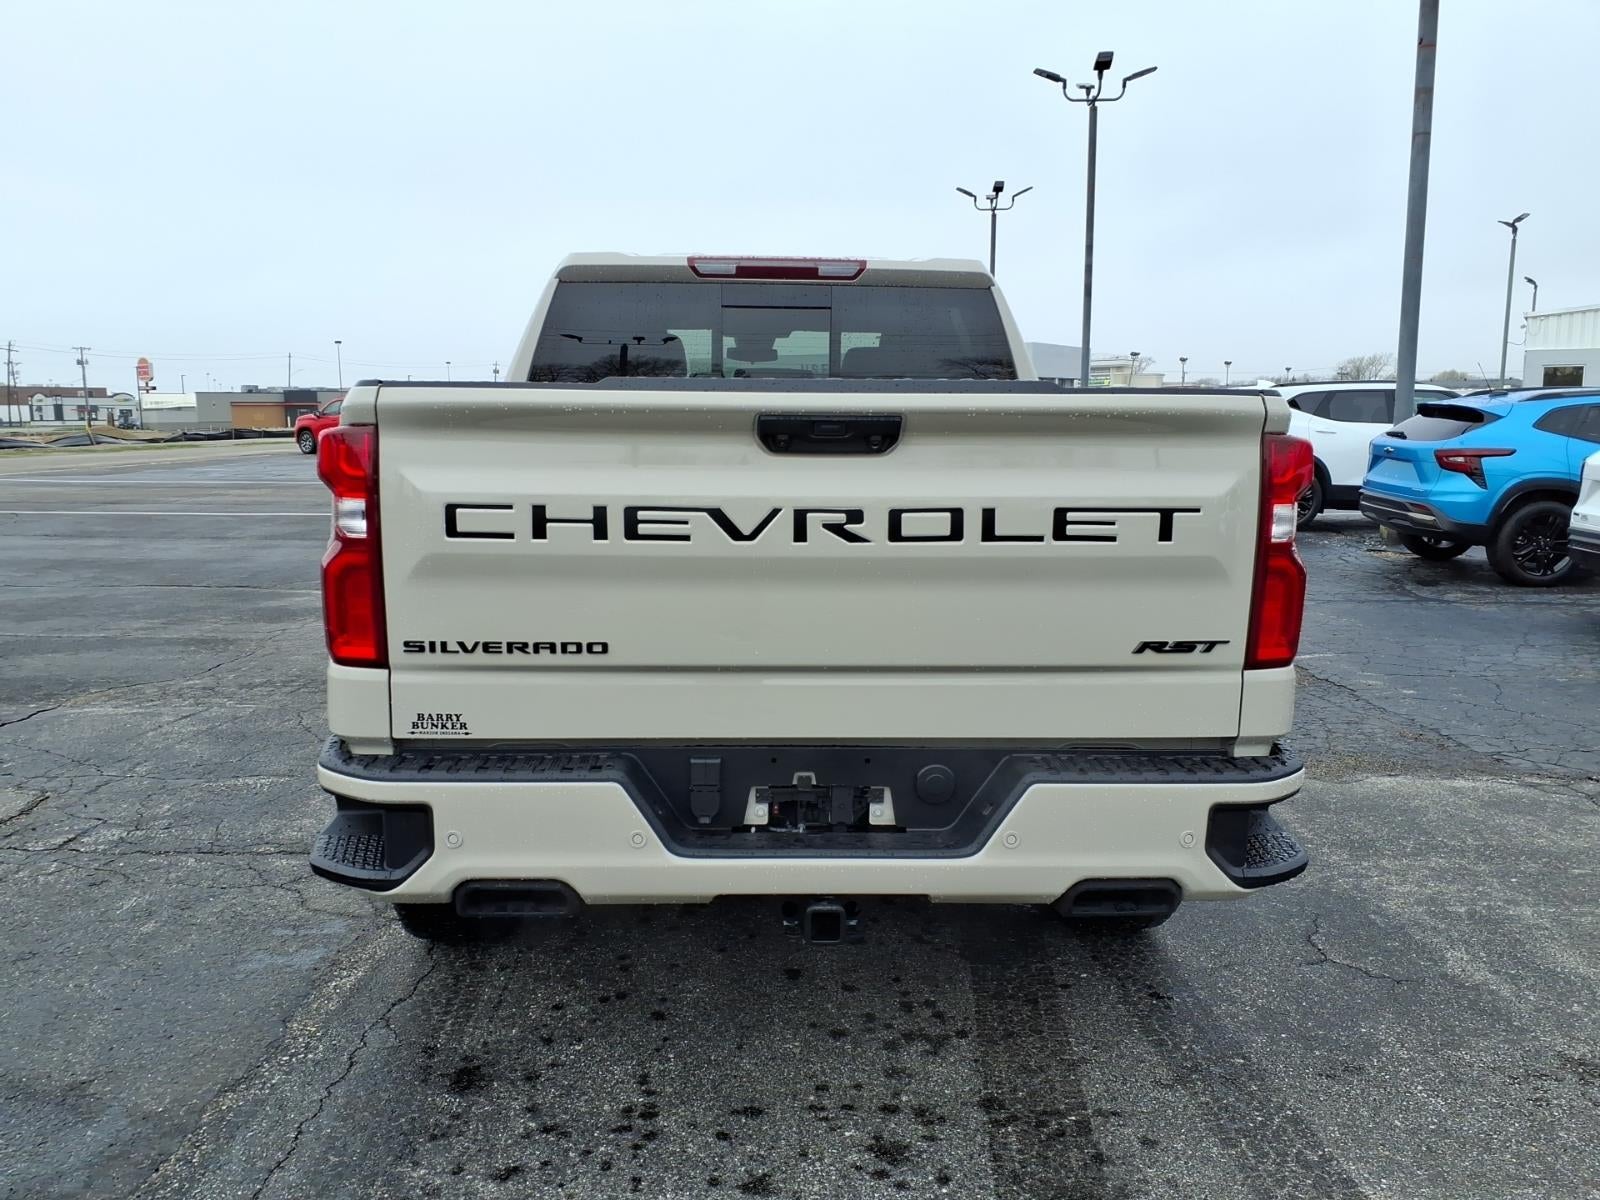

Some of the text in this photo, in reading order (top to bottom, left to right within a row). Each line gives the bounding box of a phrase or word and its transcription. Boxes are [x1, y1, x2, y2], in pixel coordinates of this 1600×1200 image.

[445, 502, 1201, 543] CHEVROLET
[403, 640, 609, 654] SILVERADO
[1131, 640, 1231, 654] RST
[416, 712, 463, 722] BARRY
[411, 721, 468, 730] BUNKER
